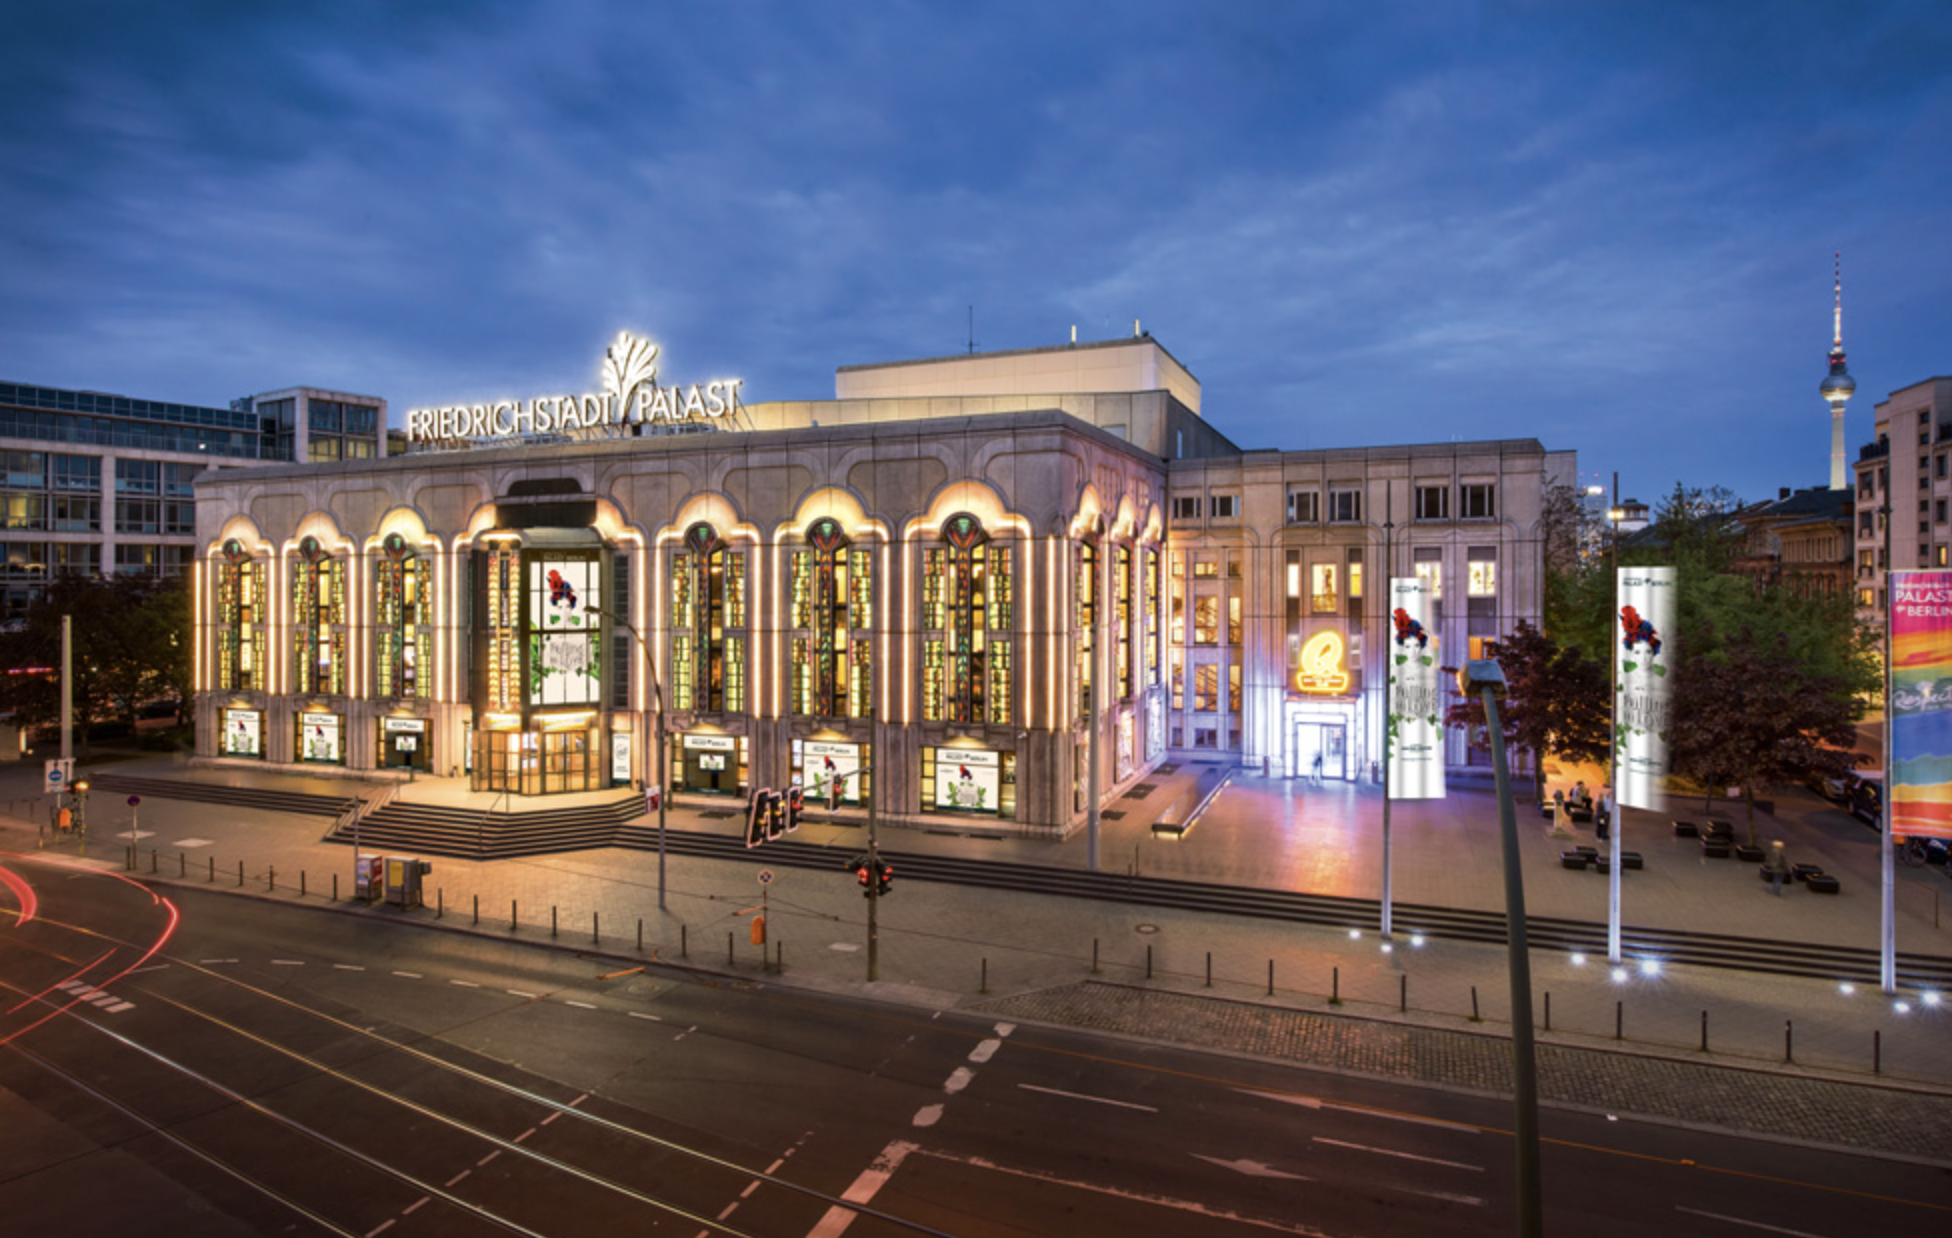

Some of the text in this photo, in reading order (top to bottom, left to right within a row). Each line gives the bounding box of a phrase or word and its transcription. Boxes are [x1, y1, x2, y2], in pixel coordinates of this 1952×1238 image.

[408, 379, 741, 441] FRIEDRICHSTADT PALAST
[1895, 590, 1952, 603] PALAST
